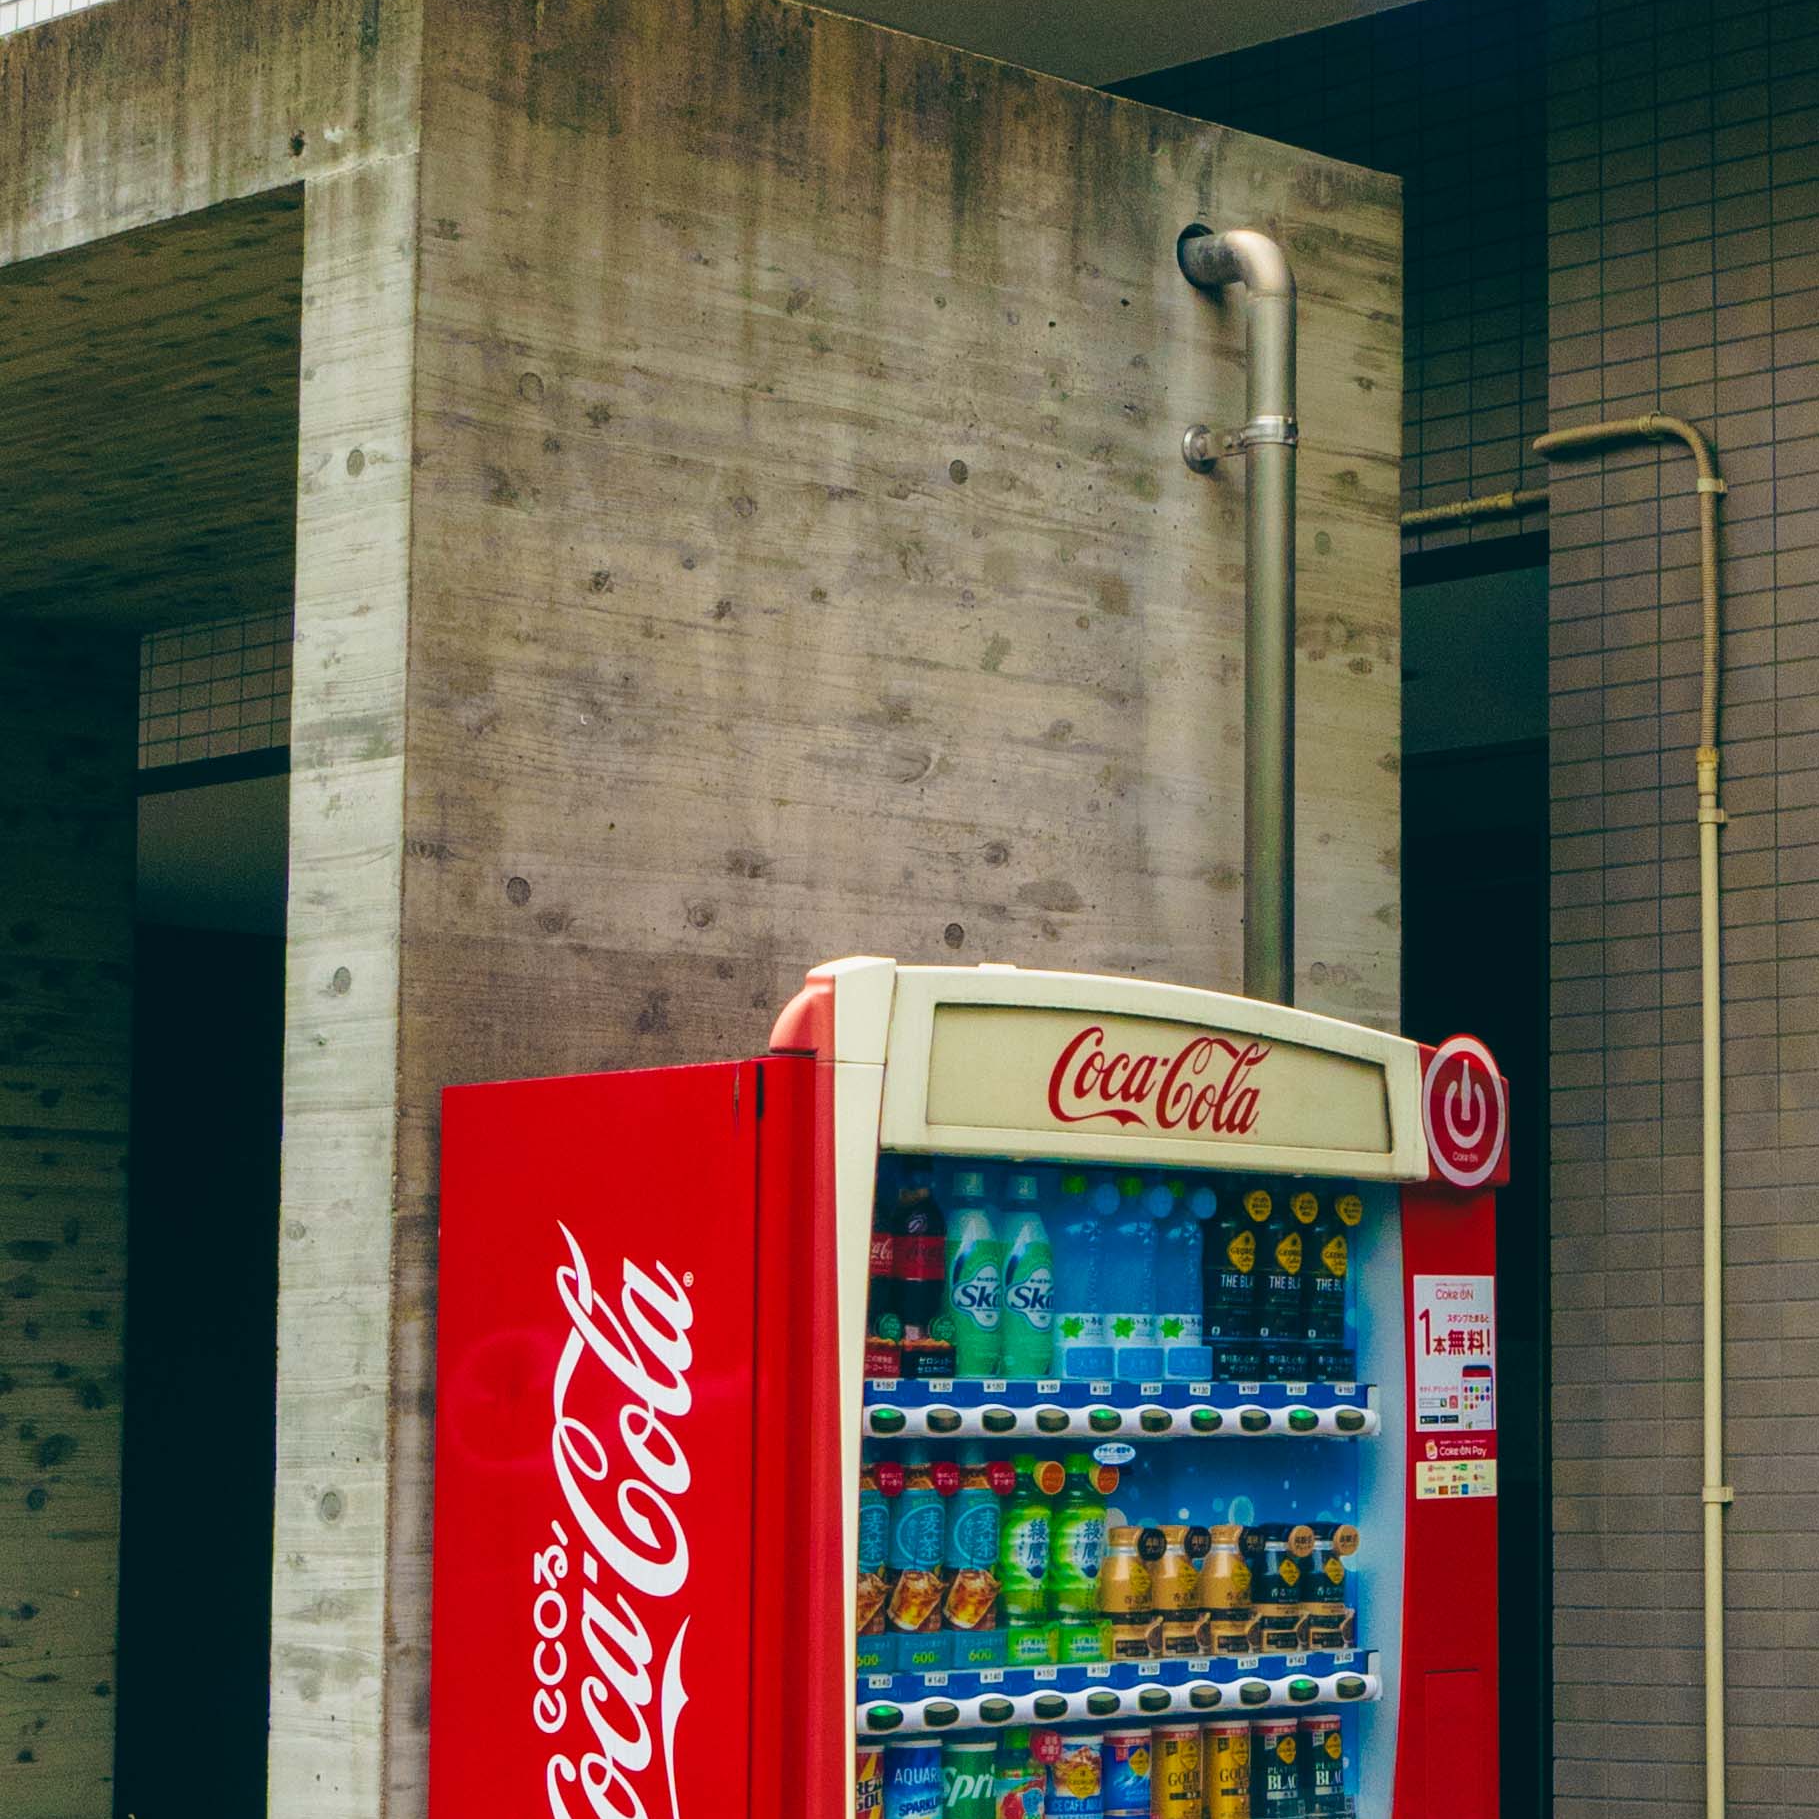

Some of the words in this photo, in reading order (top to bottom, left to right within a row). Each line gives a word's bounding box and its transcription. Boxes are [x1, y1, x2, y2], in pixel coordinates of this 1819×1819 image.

[1047, 1026, 1272, 1136] Coca-Cola
[1221, 1274, 1238, 1288] THE
[1269, 1276, 1286, 1290] THE
[1316, 1278, 1333, 1292] THE
[1436, 1289, 1459, 1301] Coke
[1460, 1288, 1474, 1301] ON
[862, 1510, 883, 1559] 麦茶
[919, 1510, 940, 1559] 麦茶
[976, 1509, 997, 1558] 麦茶
